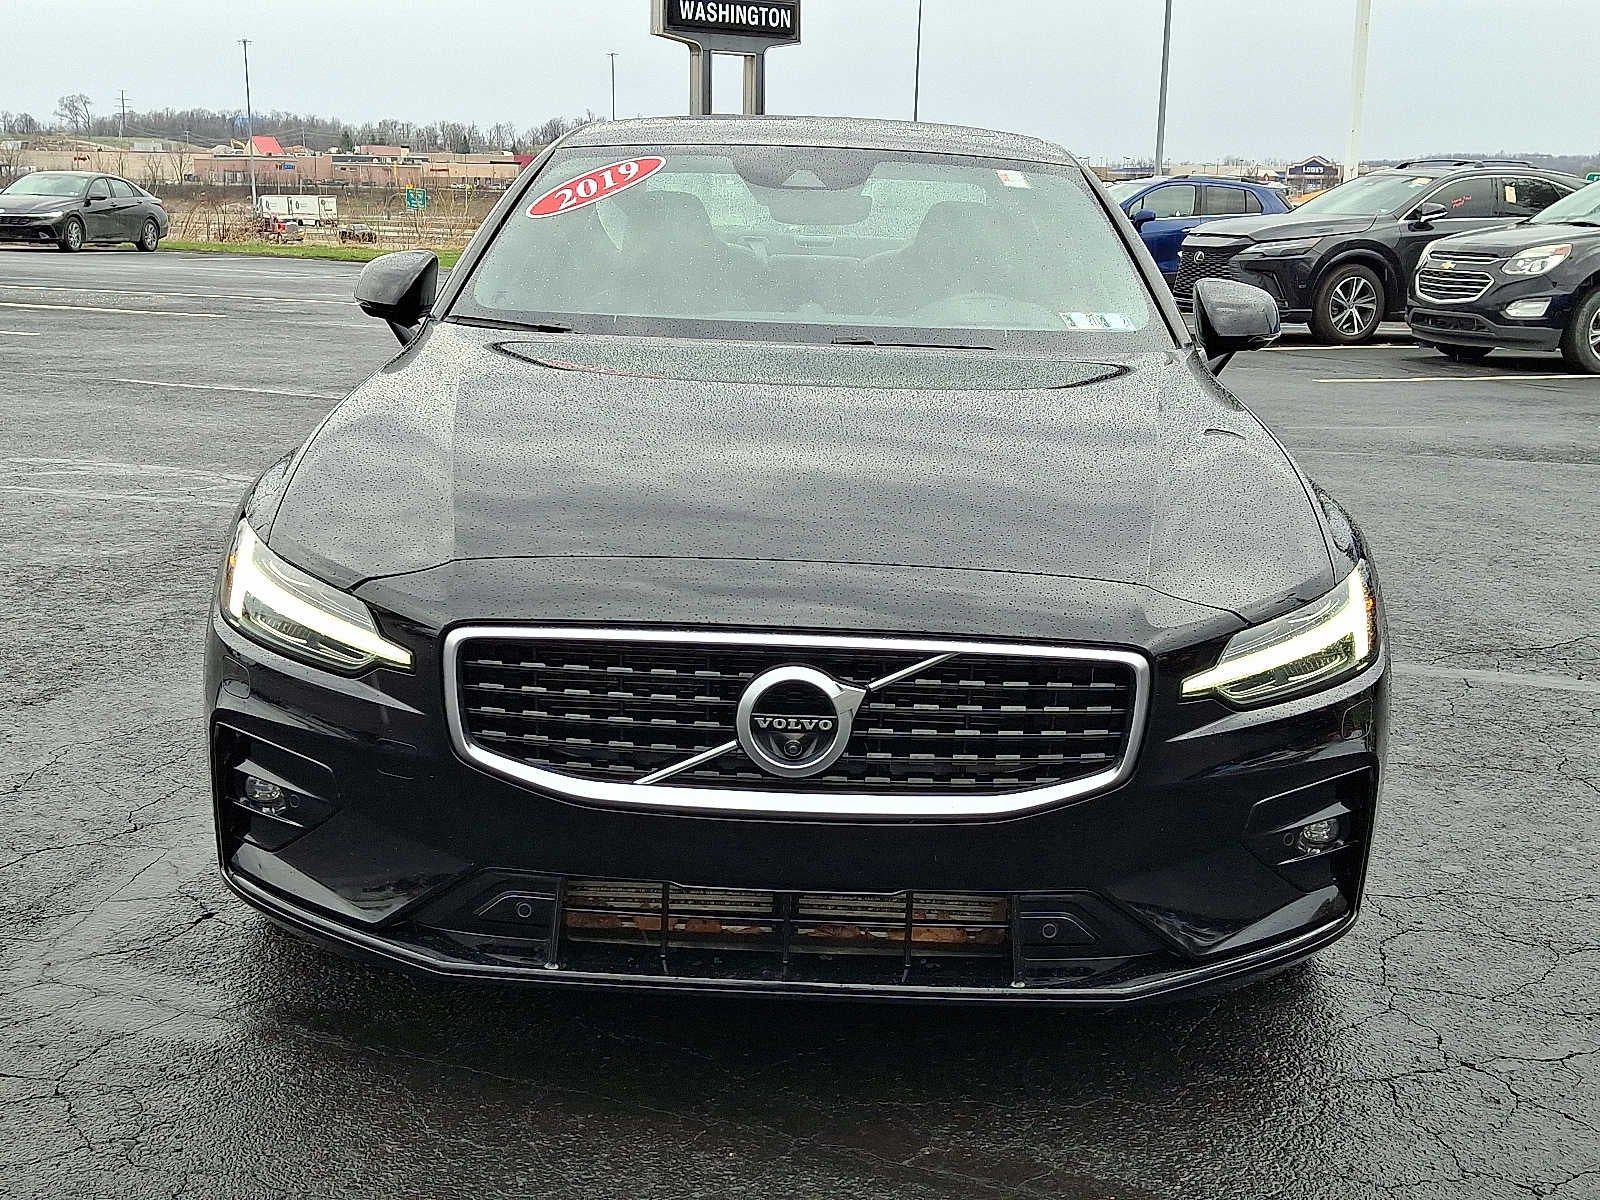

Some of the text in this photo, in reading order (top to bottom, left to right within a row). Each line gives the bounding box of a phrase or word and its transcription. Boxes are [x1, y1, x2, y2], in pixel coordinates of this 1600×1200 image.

[679, 0, 791, 28] WASHINGTON
[554, 161, 639, 209] 2019
[753, 717, 833, 730] VOLVO
